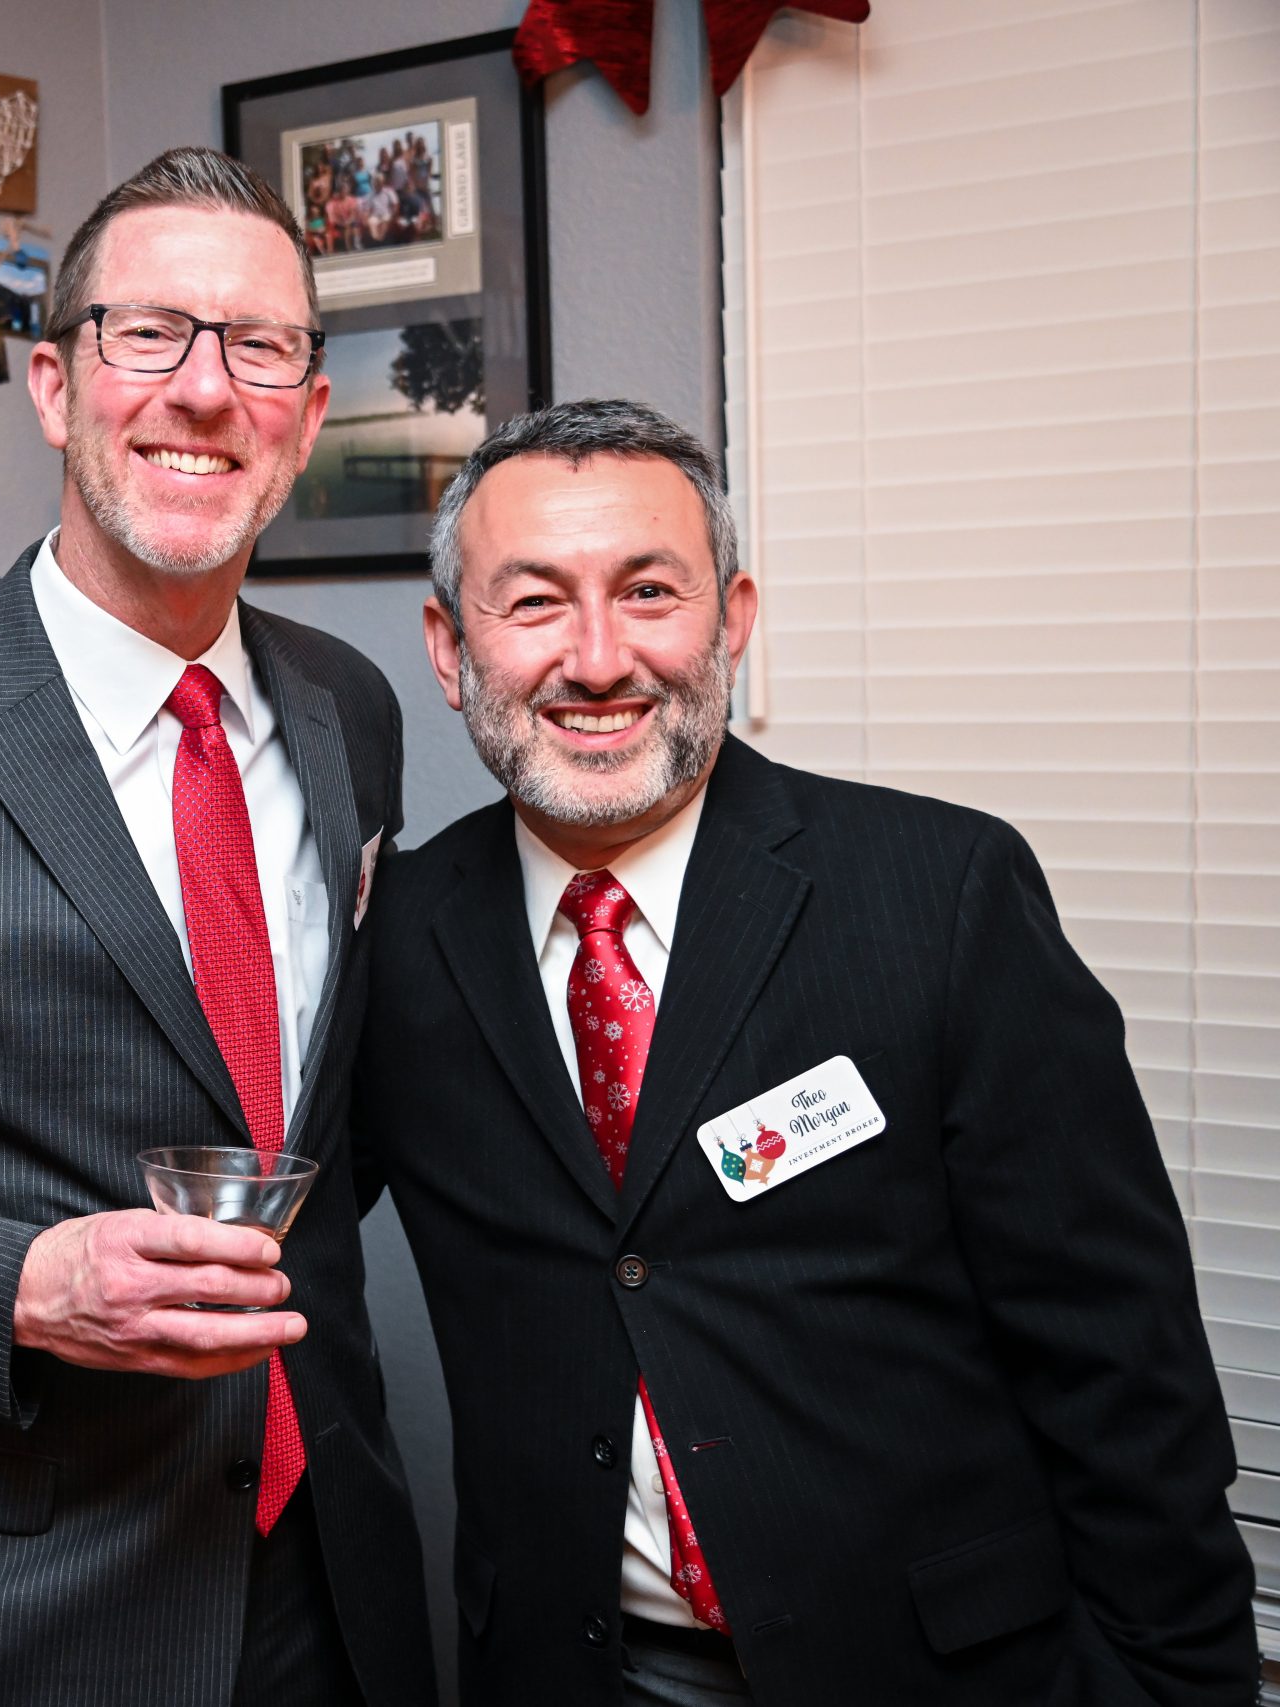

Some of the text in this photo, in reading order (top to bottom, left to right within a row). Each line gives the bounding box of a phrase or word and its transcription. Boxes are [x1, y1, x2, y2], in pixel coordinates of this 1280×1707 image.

[791, 1089, 827, 1110] Theo
[789, 1101, 851, 1137] Morgan
[788, 1116, 880, 1165] INVESTMENT BROKER
